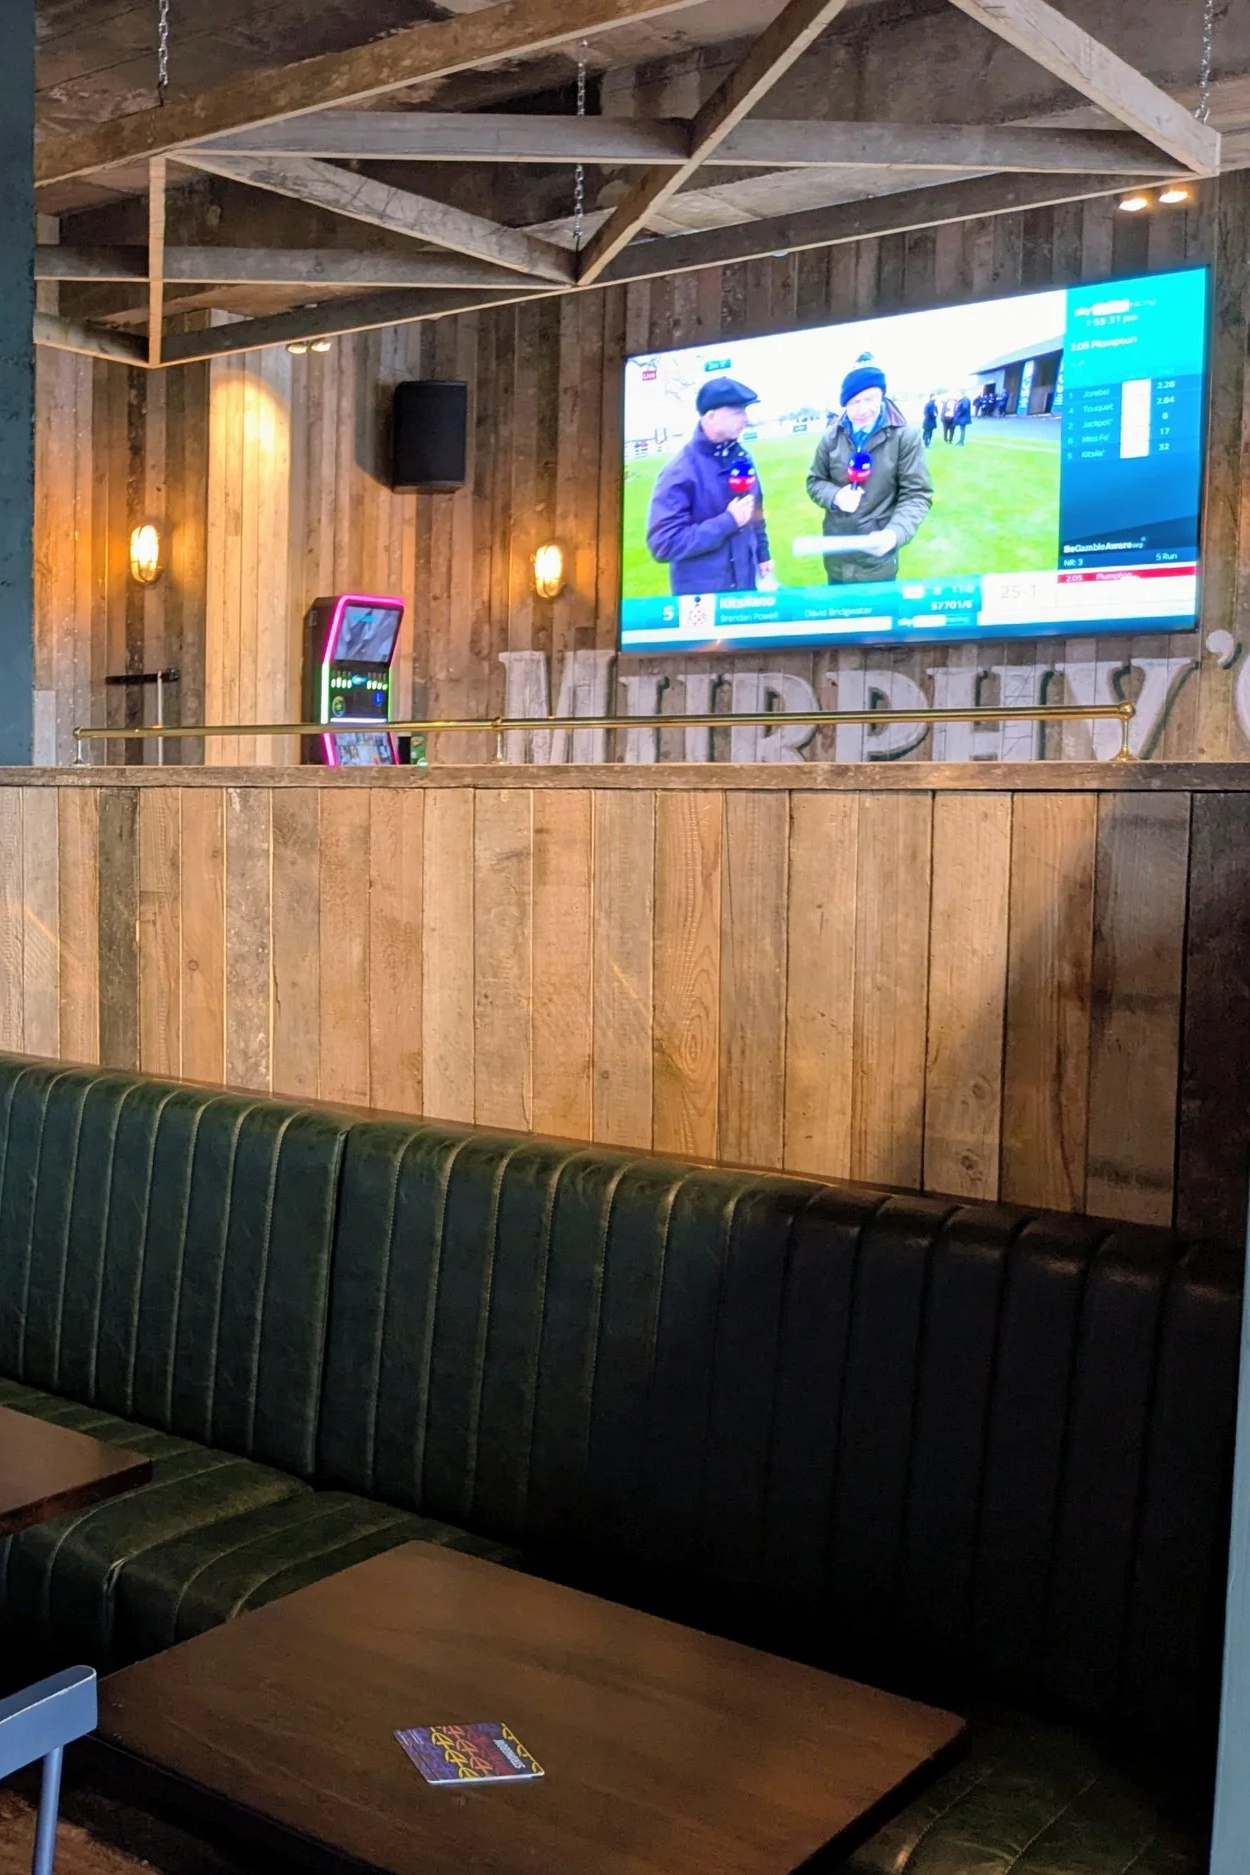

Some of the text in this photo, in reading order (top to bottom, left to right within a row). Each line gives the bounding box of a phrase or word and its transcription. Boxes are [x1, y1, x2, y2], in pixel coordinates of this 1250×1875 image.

[1070, 336, 1138, 351] 2.05 Plumpton
[1001, 585, 1036, 599] 25-1
[720, 595, 777, 609] Kitsilano
[663, 606, 674, 621] 5
[721, 611, 779, 622] Brendan Powell
[805, 609, 827, 617] David
[498, 629, 1250, 764] MURPHY'
